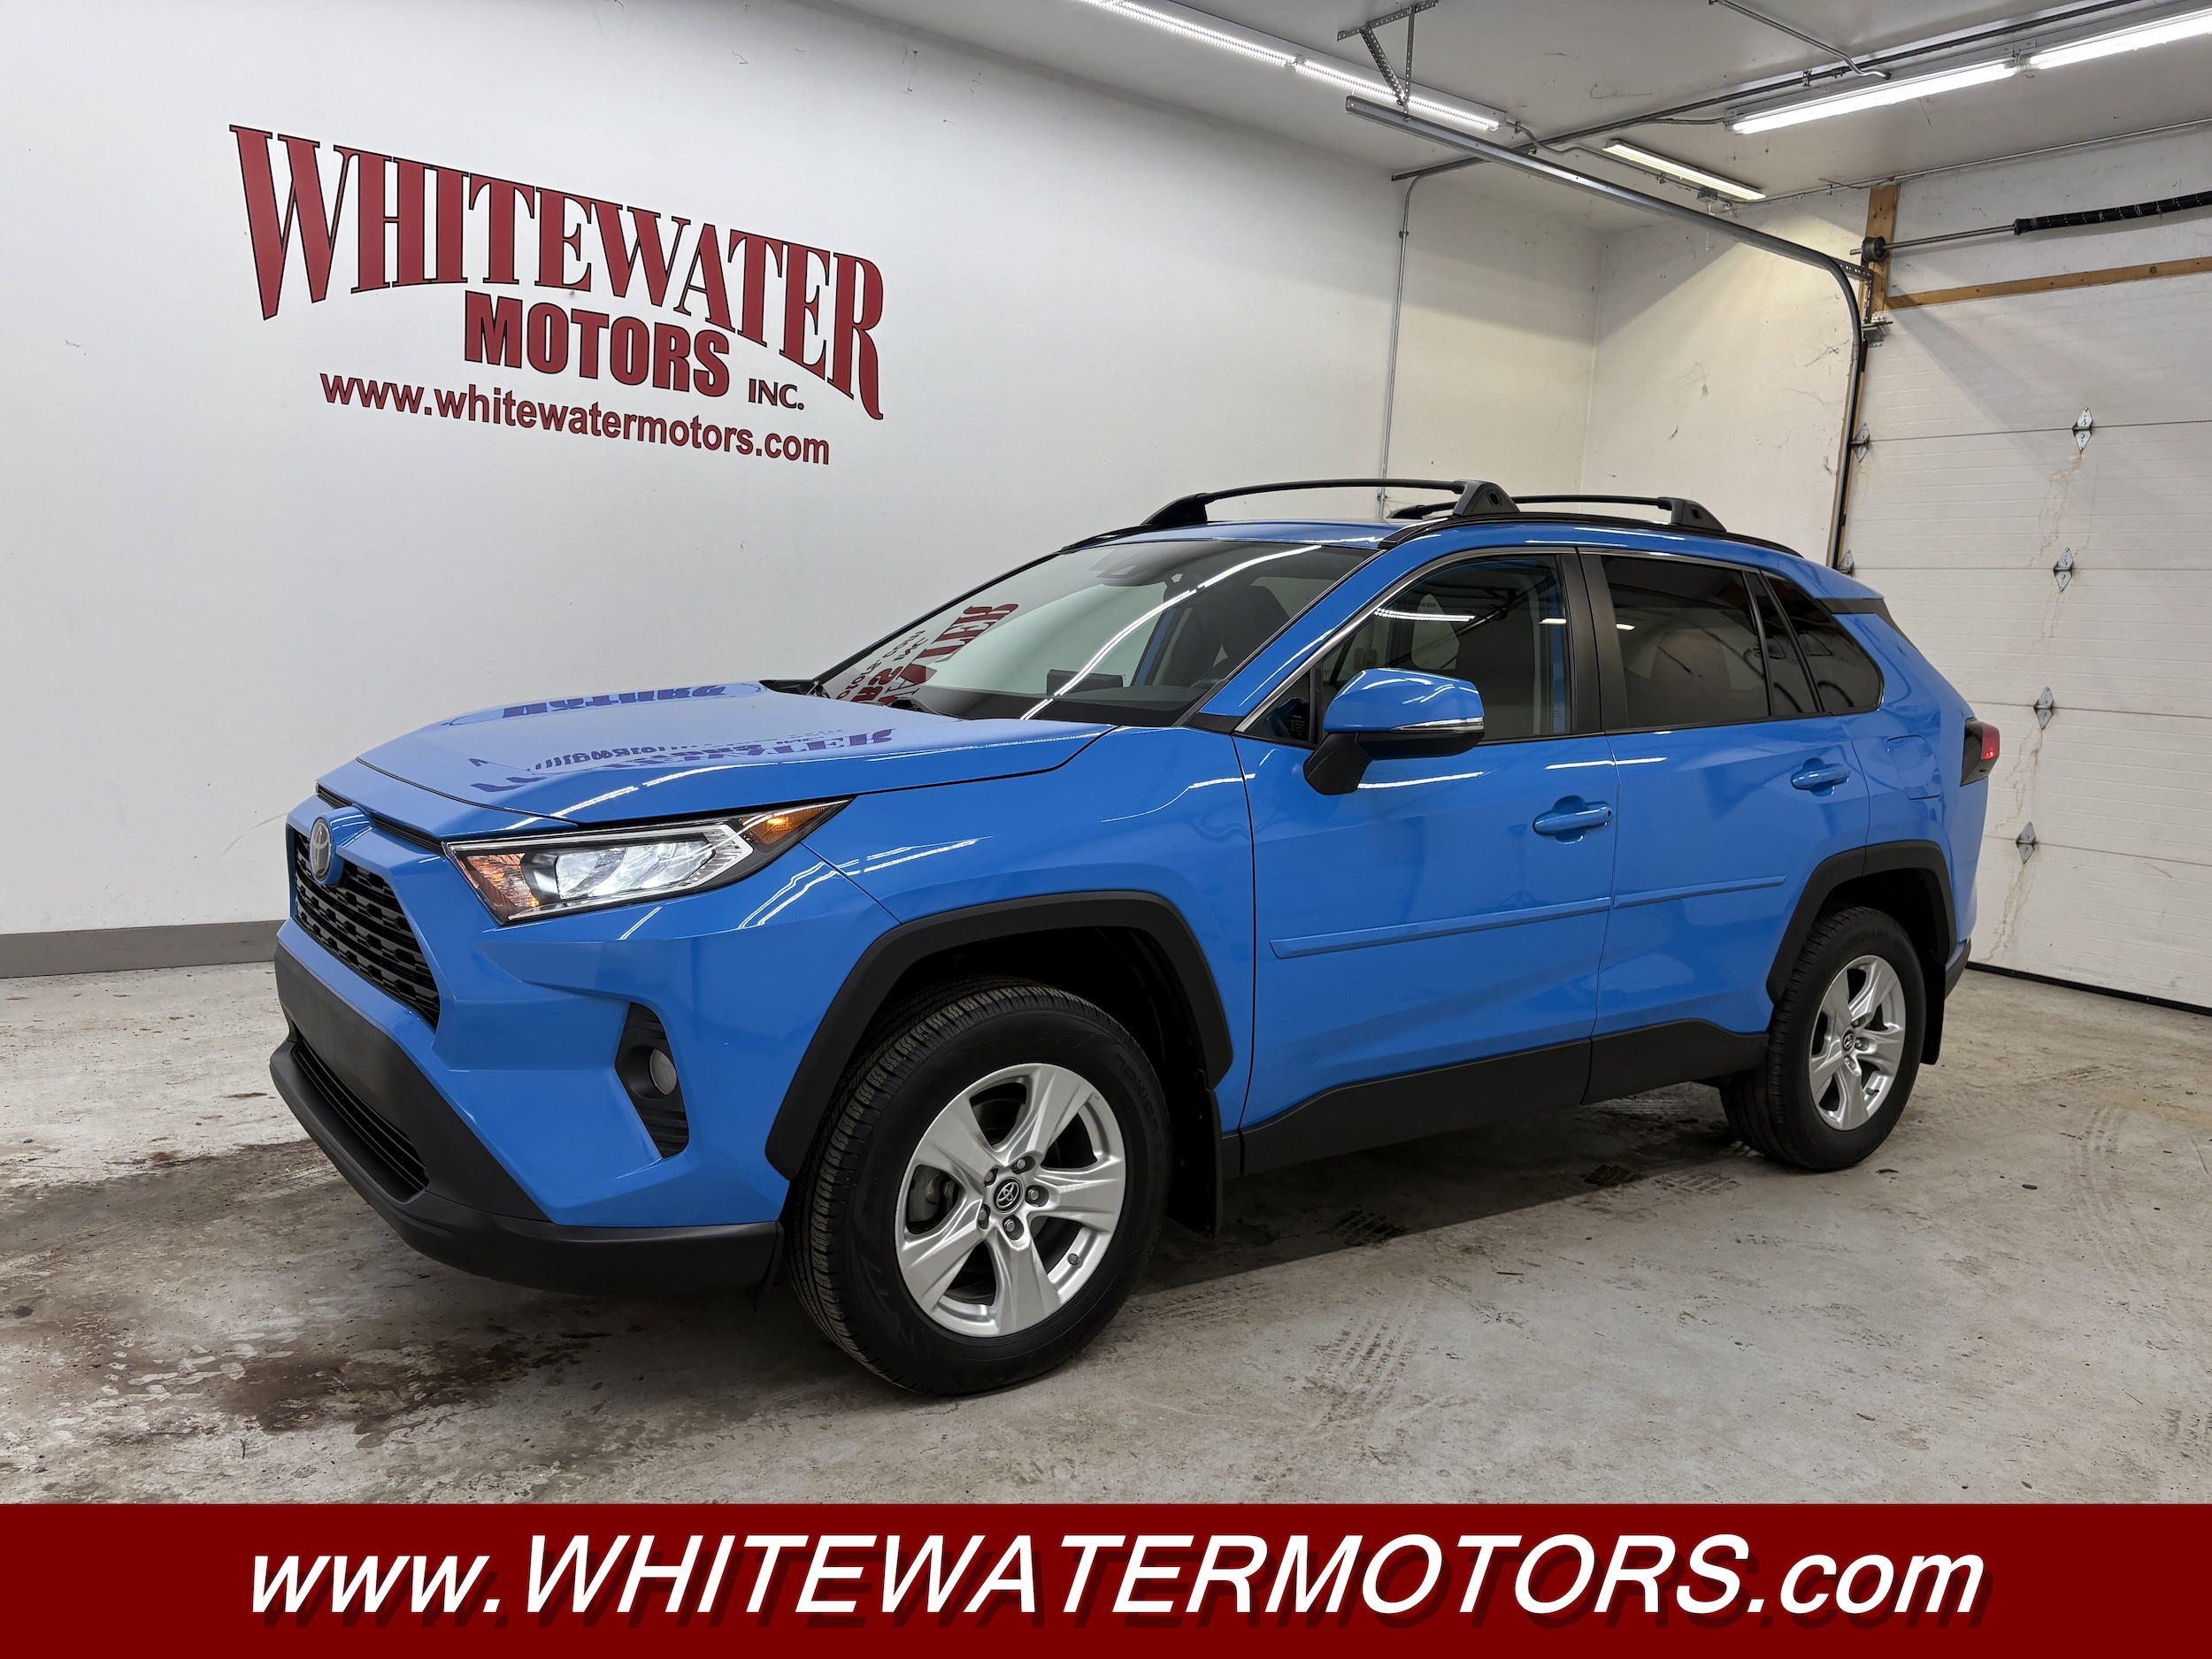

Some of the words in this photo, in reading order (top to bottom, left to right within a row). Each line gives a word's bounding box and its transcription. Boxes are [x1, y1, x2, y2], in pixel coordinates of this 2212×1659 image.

[229, 125, 883, 420] WHITEWATER
[465, 290, 729, 397] MOTORS
[749, 379, 804, 410] INC.
[319, 373, 829, 465] www.whitewatermotors.com
